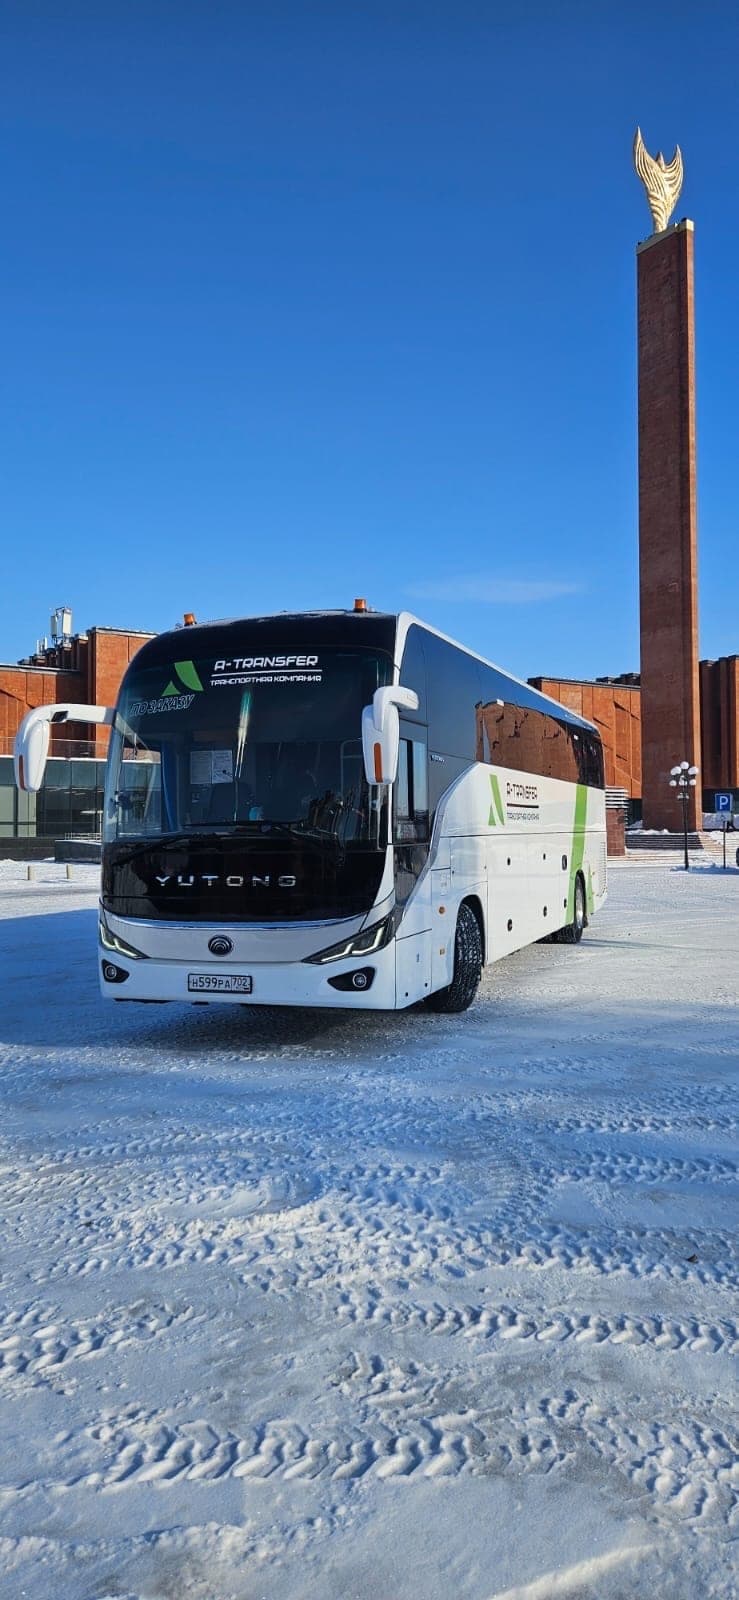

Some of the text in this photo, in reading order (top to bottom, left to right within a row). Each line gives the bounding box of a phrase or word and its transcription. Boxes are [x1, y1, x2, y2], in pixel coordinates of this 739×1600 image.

[214, 656, 319, 671] A-TRANSFER
[210, 675, 322, 686] ТРАНСПОРТНАЯ КОМПАНИЯ
[130, 694, 195, 717] ПО ЗАКАЗУ
[719, 795, 729, 810] P
[155, 875, 297, 887] YUTONG
[232, 977, 248, 987] 702
